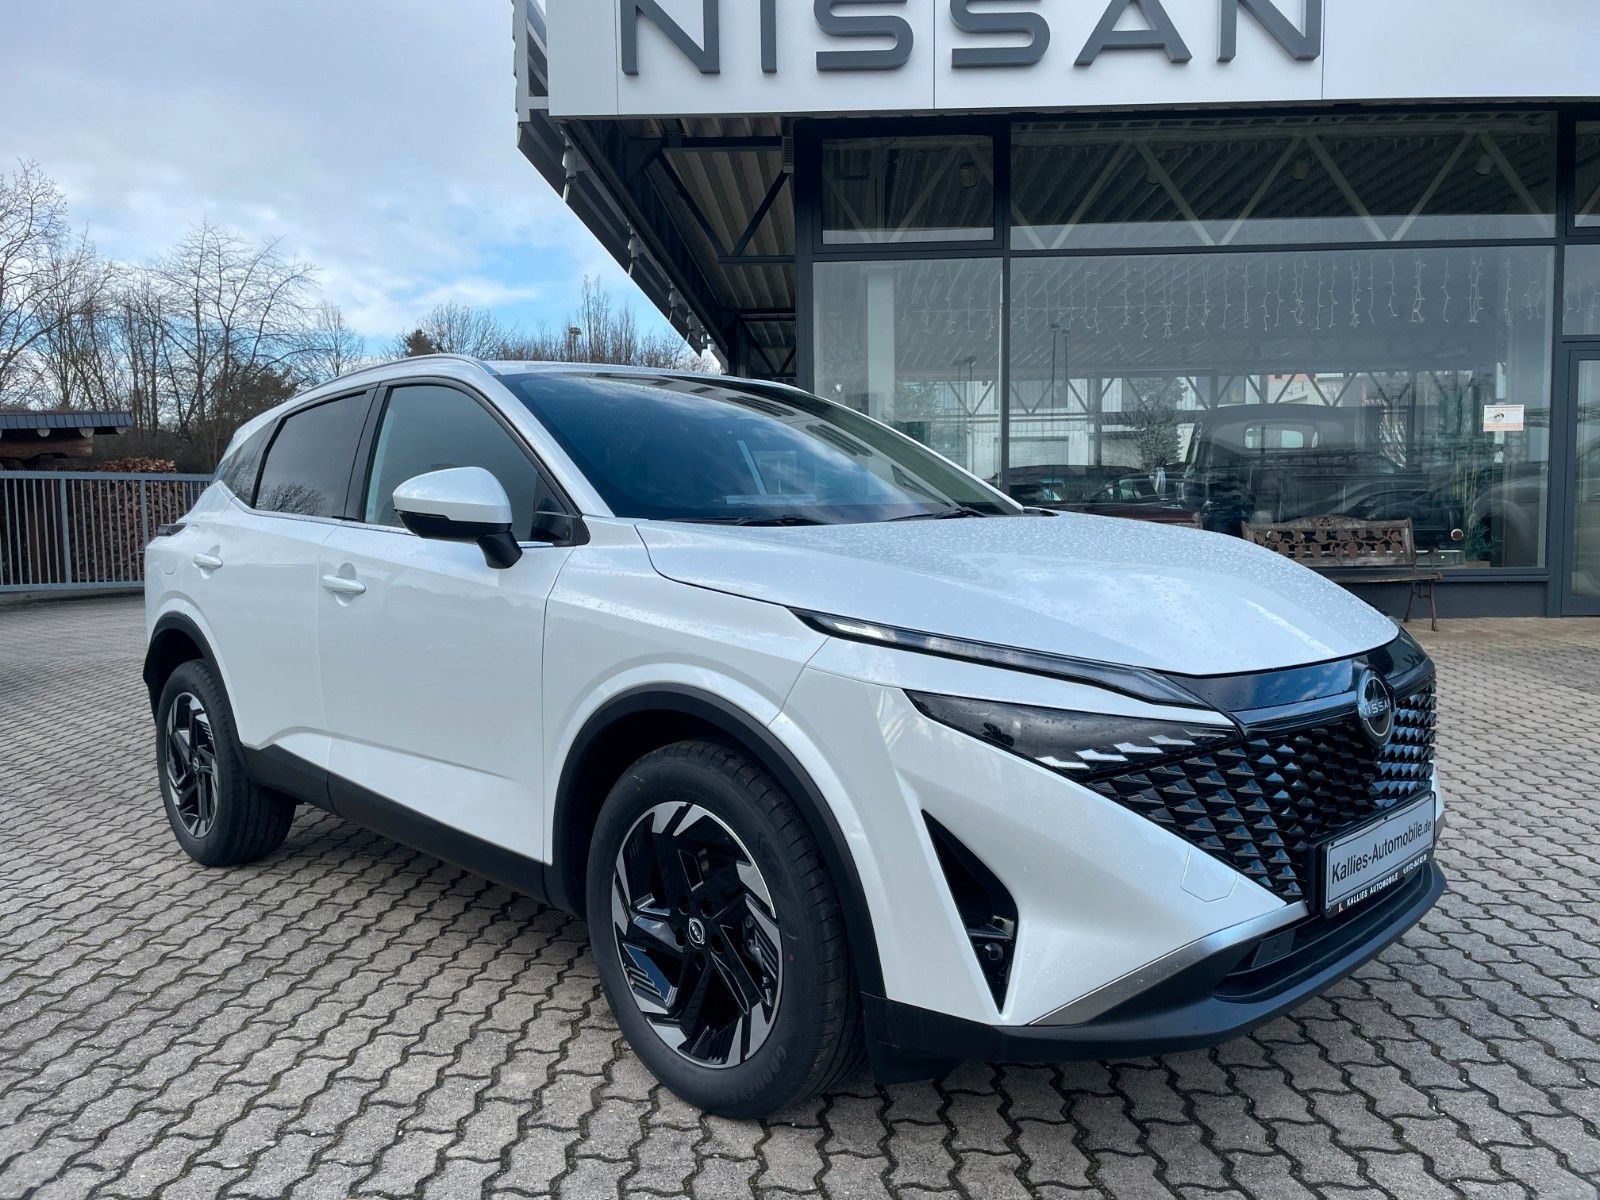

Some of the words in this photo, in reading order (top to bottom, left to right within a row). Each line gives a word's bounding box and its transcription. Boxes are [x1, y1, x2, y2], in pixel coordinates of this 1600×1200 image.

[621, 0, 1320, 75] NISSAN
[1331, 820, 1432, 885] Kallies-Automobile.de
[1346, 890, 1368, 906] KALLIES
[1370, 872, 1399, 895] AUTOMOBILE
